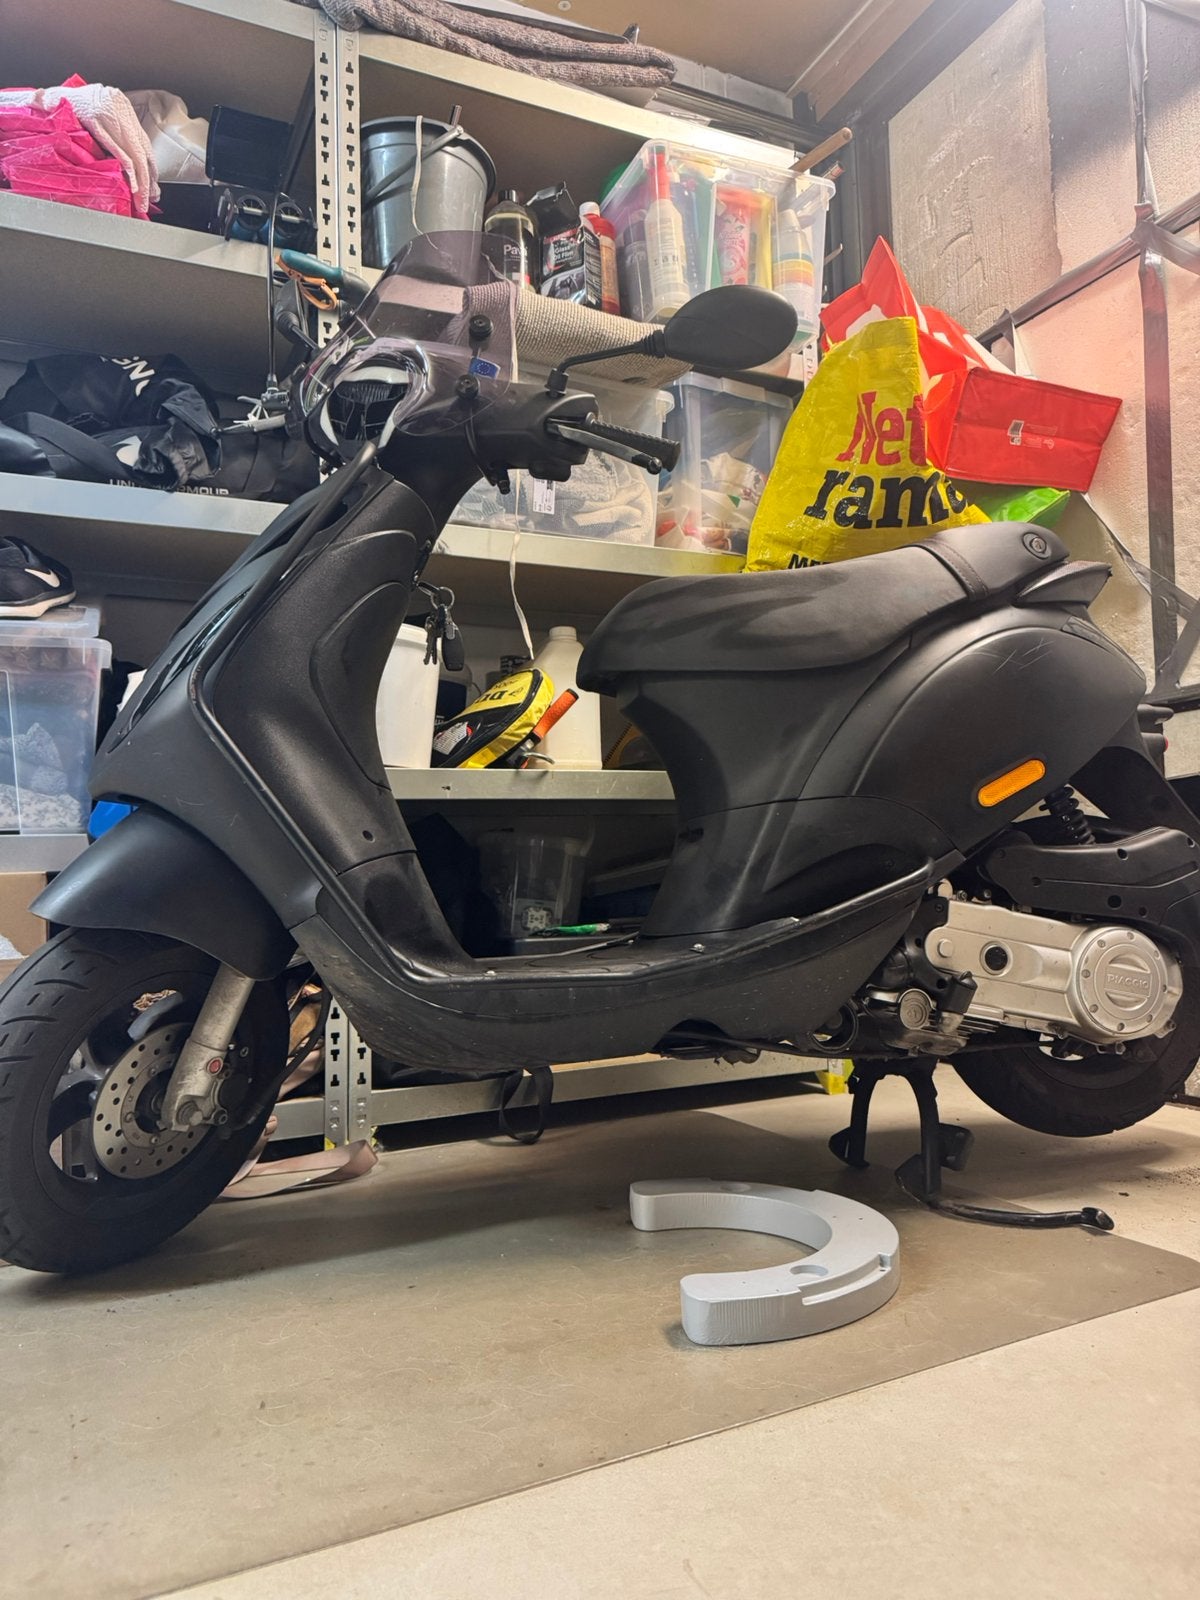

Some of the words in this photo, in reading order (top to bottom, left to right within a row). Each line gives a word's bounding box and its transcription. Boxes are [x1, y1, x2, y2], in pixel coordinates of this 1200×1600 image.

[835, 391, 929, 467] Net
[177, 485, 230, 496] RMOUR
[1106, 974, 1149, 989] PIAGGIO
